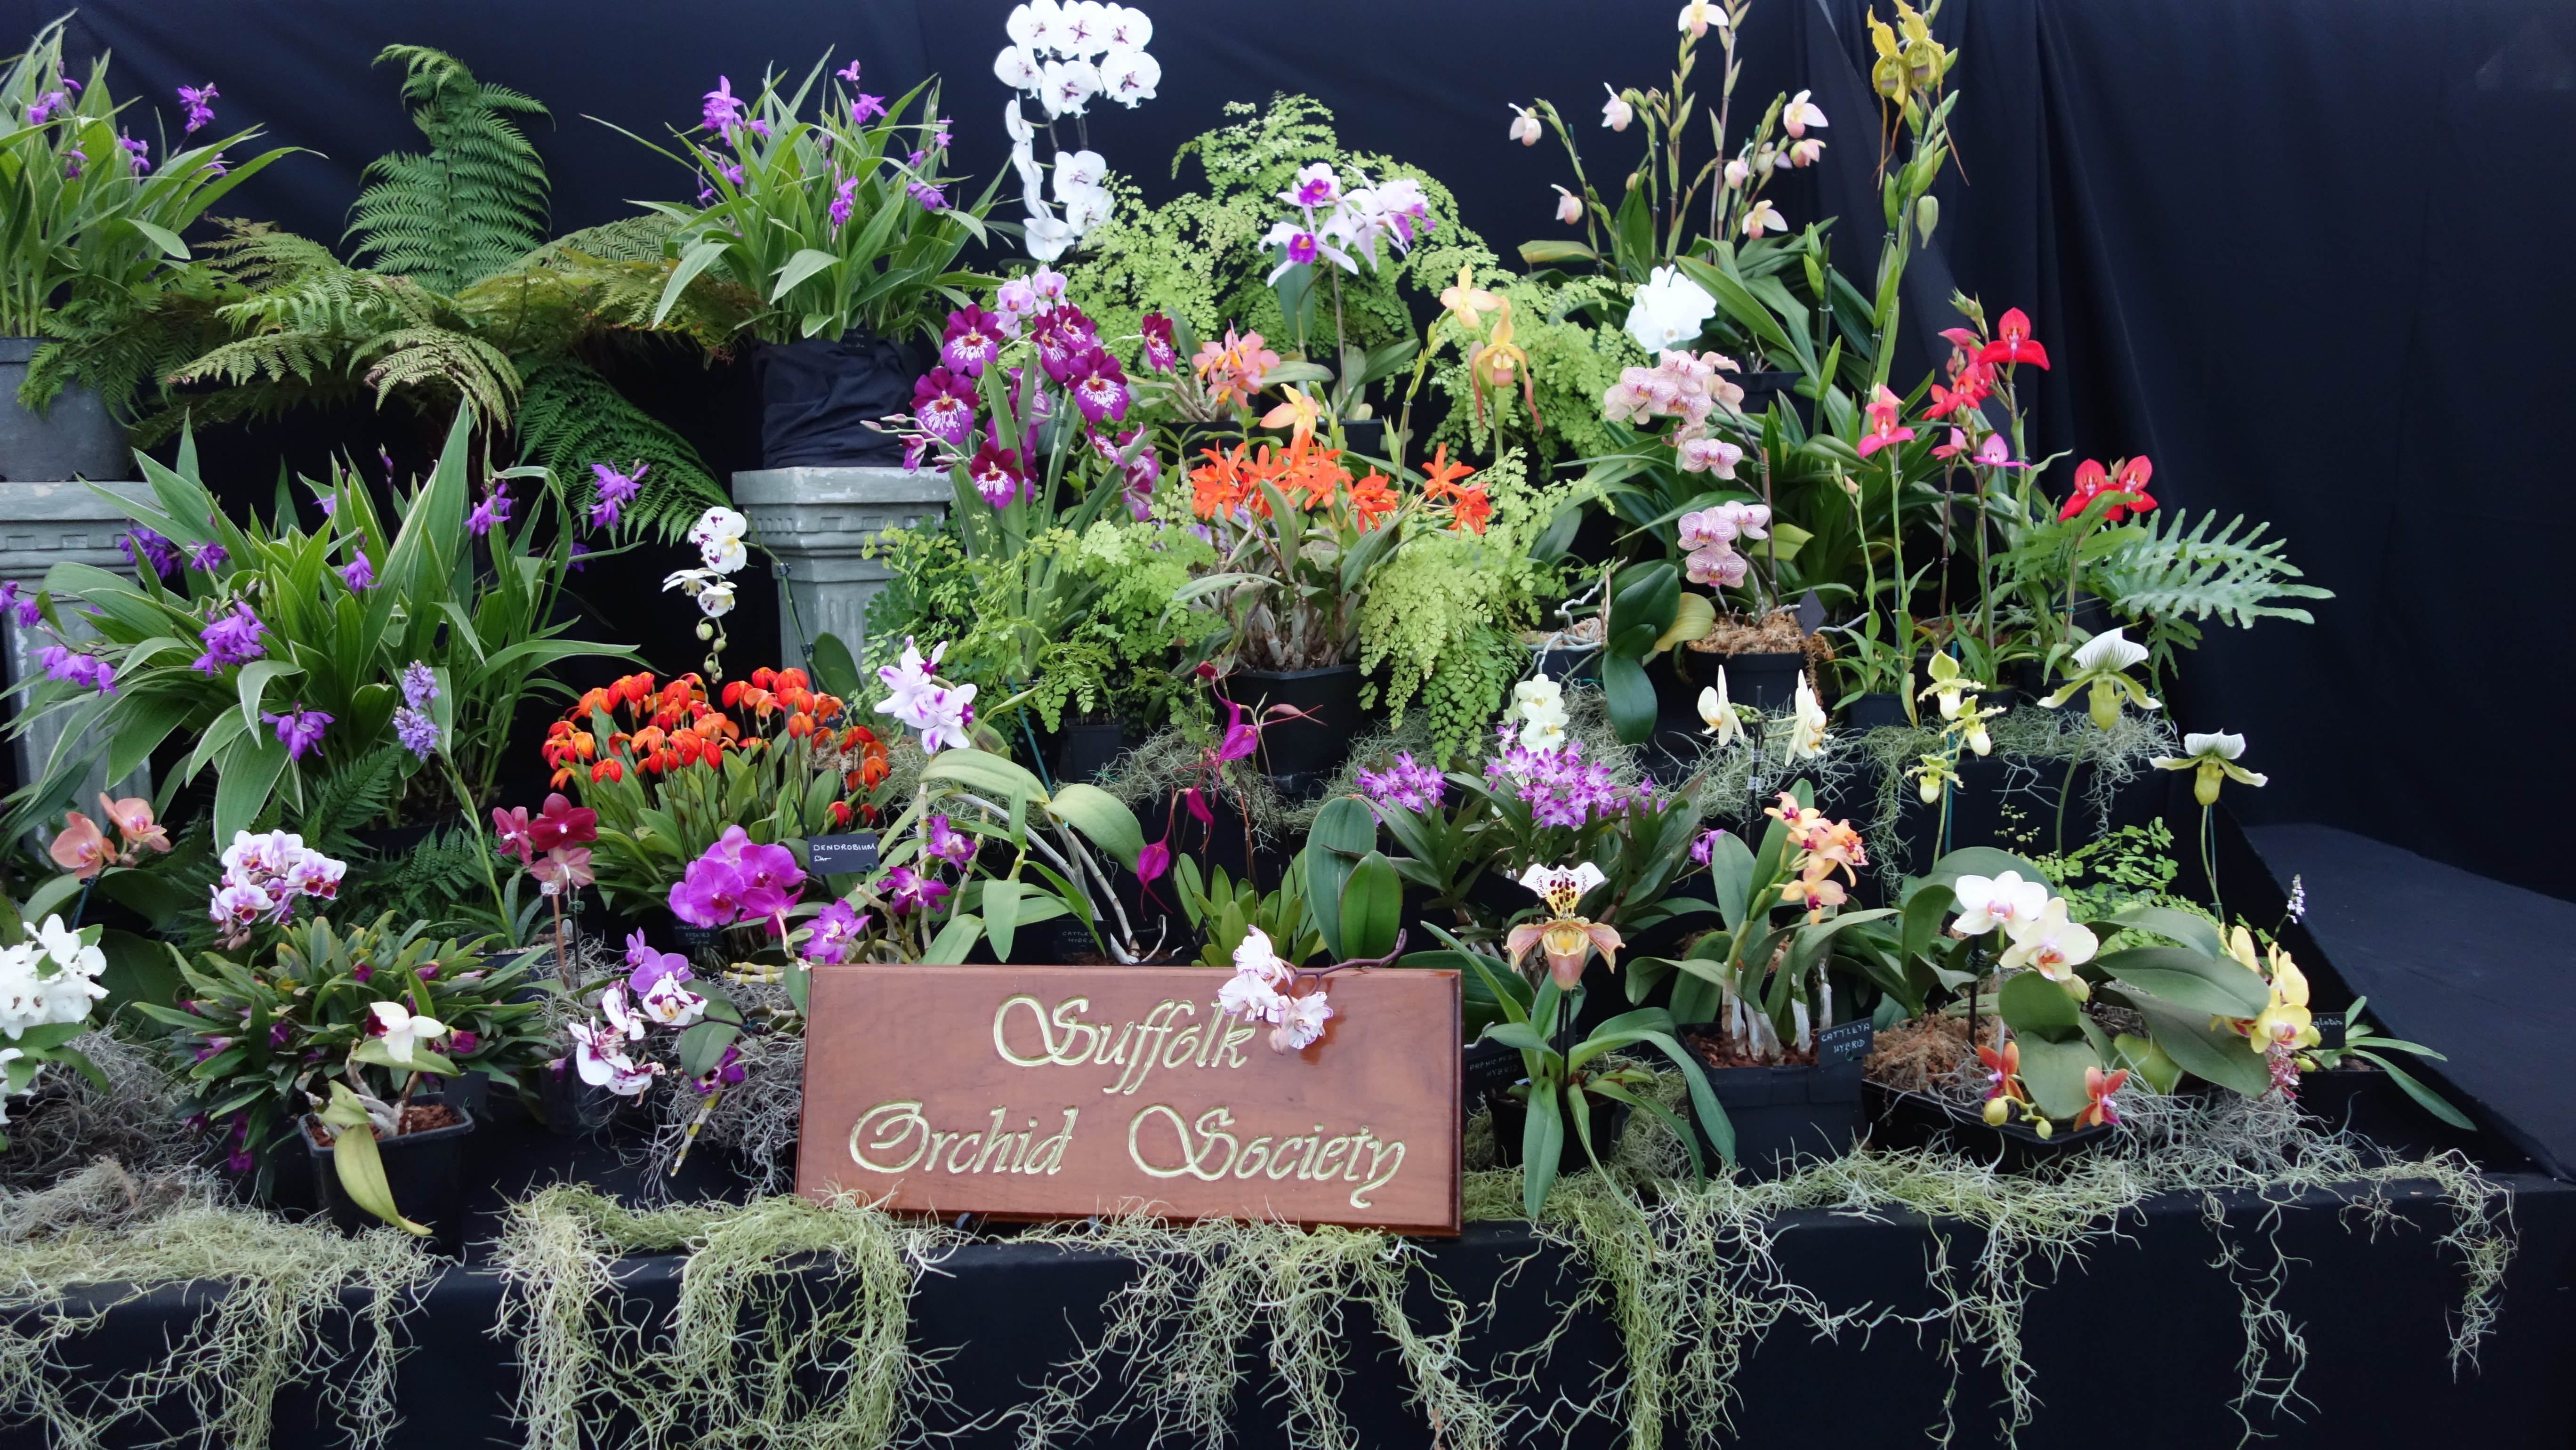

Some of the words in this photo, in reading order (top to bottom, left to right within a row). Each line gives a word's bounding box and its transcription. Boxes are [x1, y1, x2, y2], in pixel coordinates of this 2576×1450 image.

[813, 843, 876, 852] DENDROBIUM
[1821, 1023, 1871, 1042] CATTLEYA
[993, 993, 1256, 1095] Suffolk
[1486, 1064, 1518, 1077] HYBRID
[849, 1098, 1079, 1174] Orchid
[1128, 1103, 1407, 1208] Society
